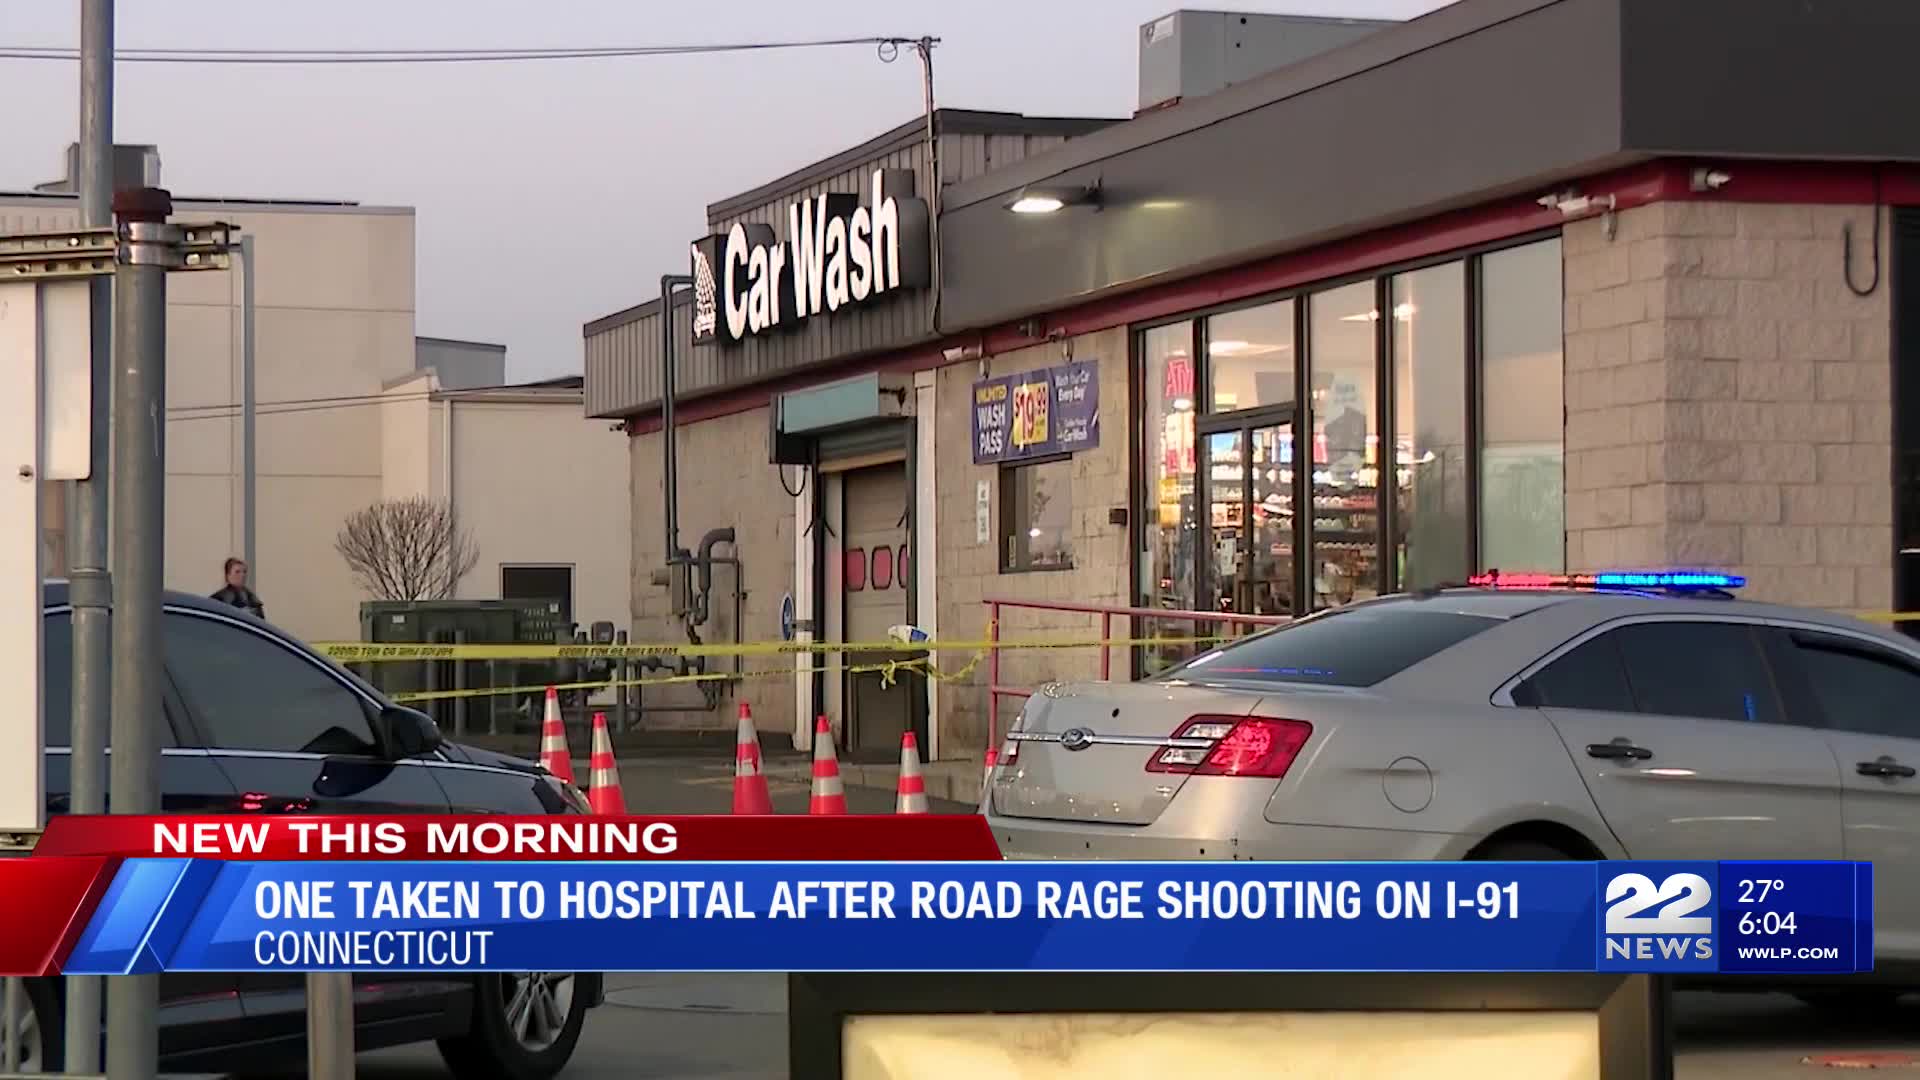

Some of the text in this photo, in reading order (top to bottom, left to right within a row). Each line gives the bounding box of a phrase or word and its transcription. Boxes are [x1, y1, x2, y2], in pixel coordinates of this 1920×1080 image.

[724, 168, 900, 340] Car Wash
[977, 403, 1006, 430] WASH
[978, 430, 1003, 456] PASS
